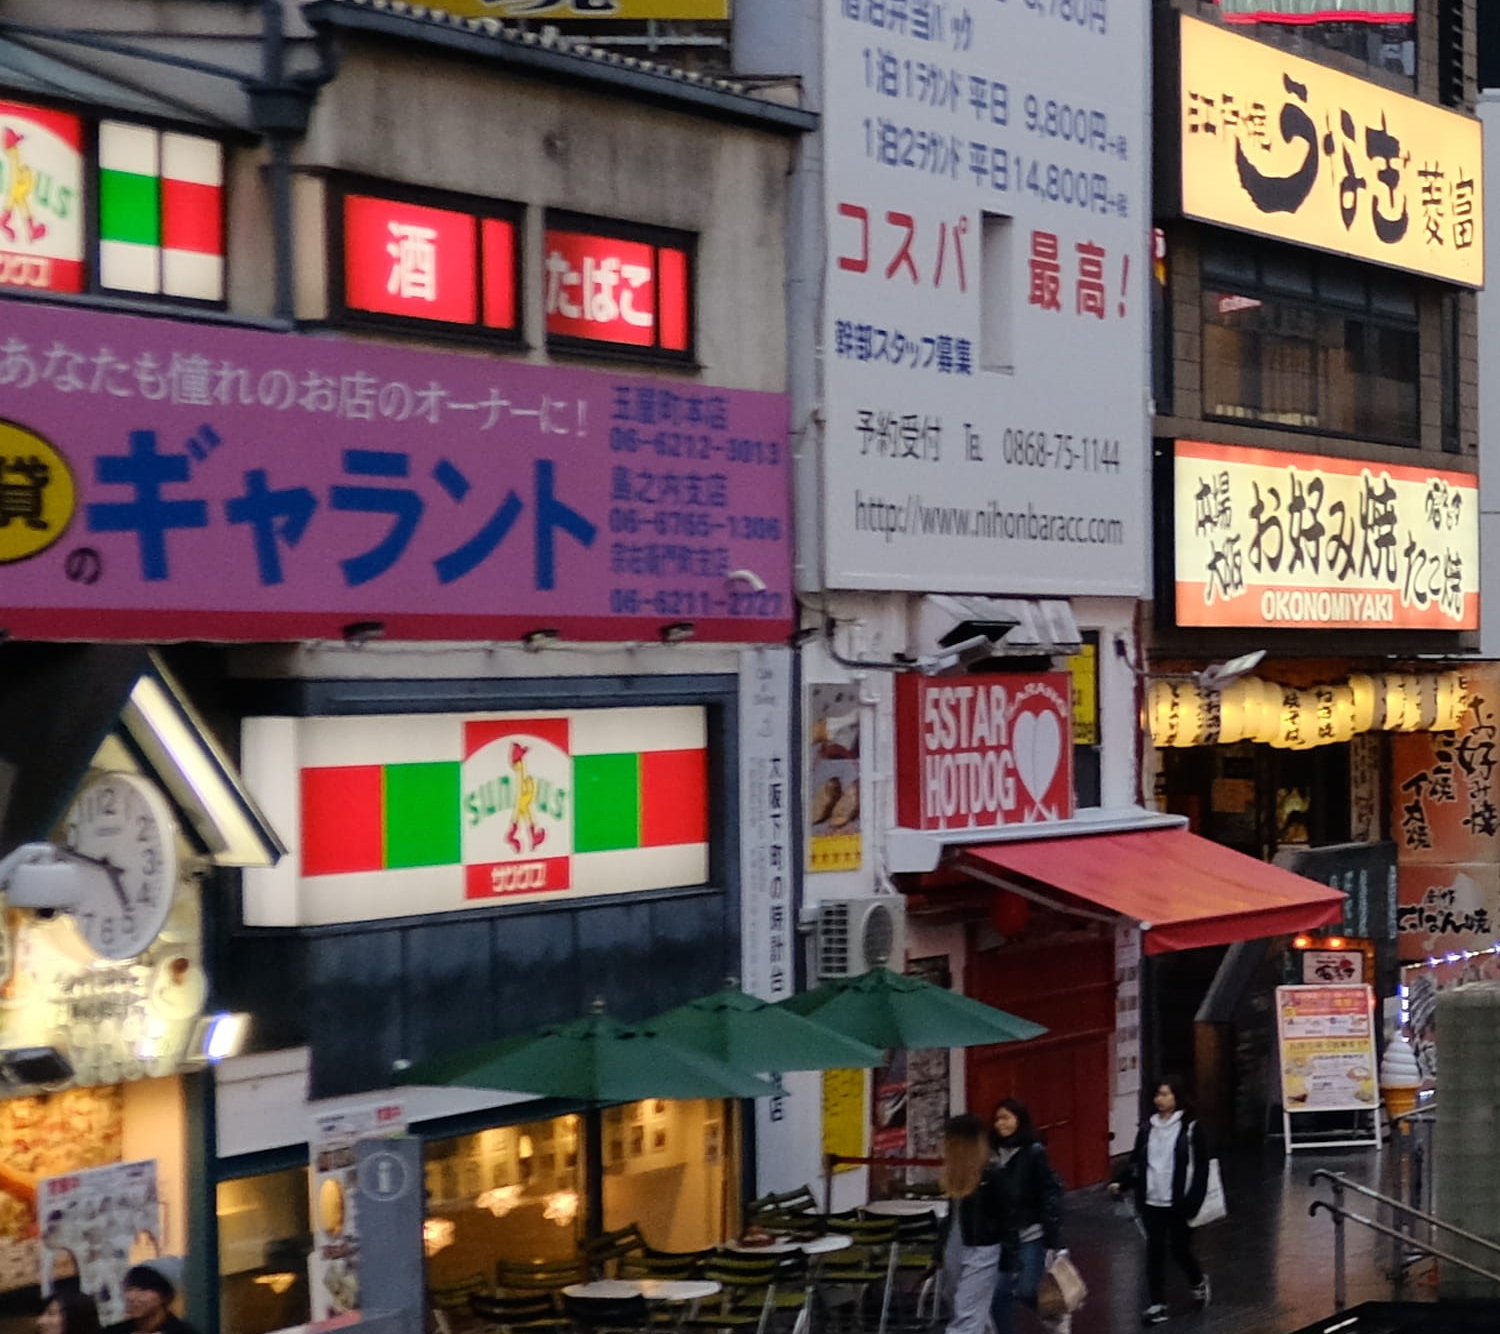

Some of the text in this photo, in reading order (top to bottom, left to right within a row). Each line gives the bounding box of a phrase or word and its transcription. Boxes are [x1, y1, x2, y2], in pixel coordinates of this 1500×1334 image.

[967, 74, 1009, 127] 平日
[968, 141, 1009, 194] 平日
[1235, 72, 1411, 245] うなぎ
[387, 222, 438, 303] 酒
[546, 252, 655, 328] たばこ
[836, 201, 1131, 321] コスパ 最高!
[834, 319, 974, 376] 幹部スタッフ募集
[0, 337, 590, 437] あなたも憧れのお店のオーナーに!
[854, 408, 944, 465] 予約受付
[1002, 424, 1122, 476] 0868-75-1144
[86, 424, 598, 592] ギャラント
[853, 488, 1125, 547] http://www.nihonbaracc.com
[1248, 472, 1398, 584] お好み焼
[1260, 589, 1394, 624] OKONOMIYAKI
[1402, 529, 1464, 619] たこ焼
[924, 684, 1008, 752] 5STAR
[926, 749, 1017, 818] HOTDOG
[1455, 695, 1500, 838] お好み焼
